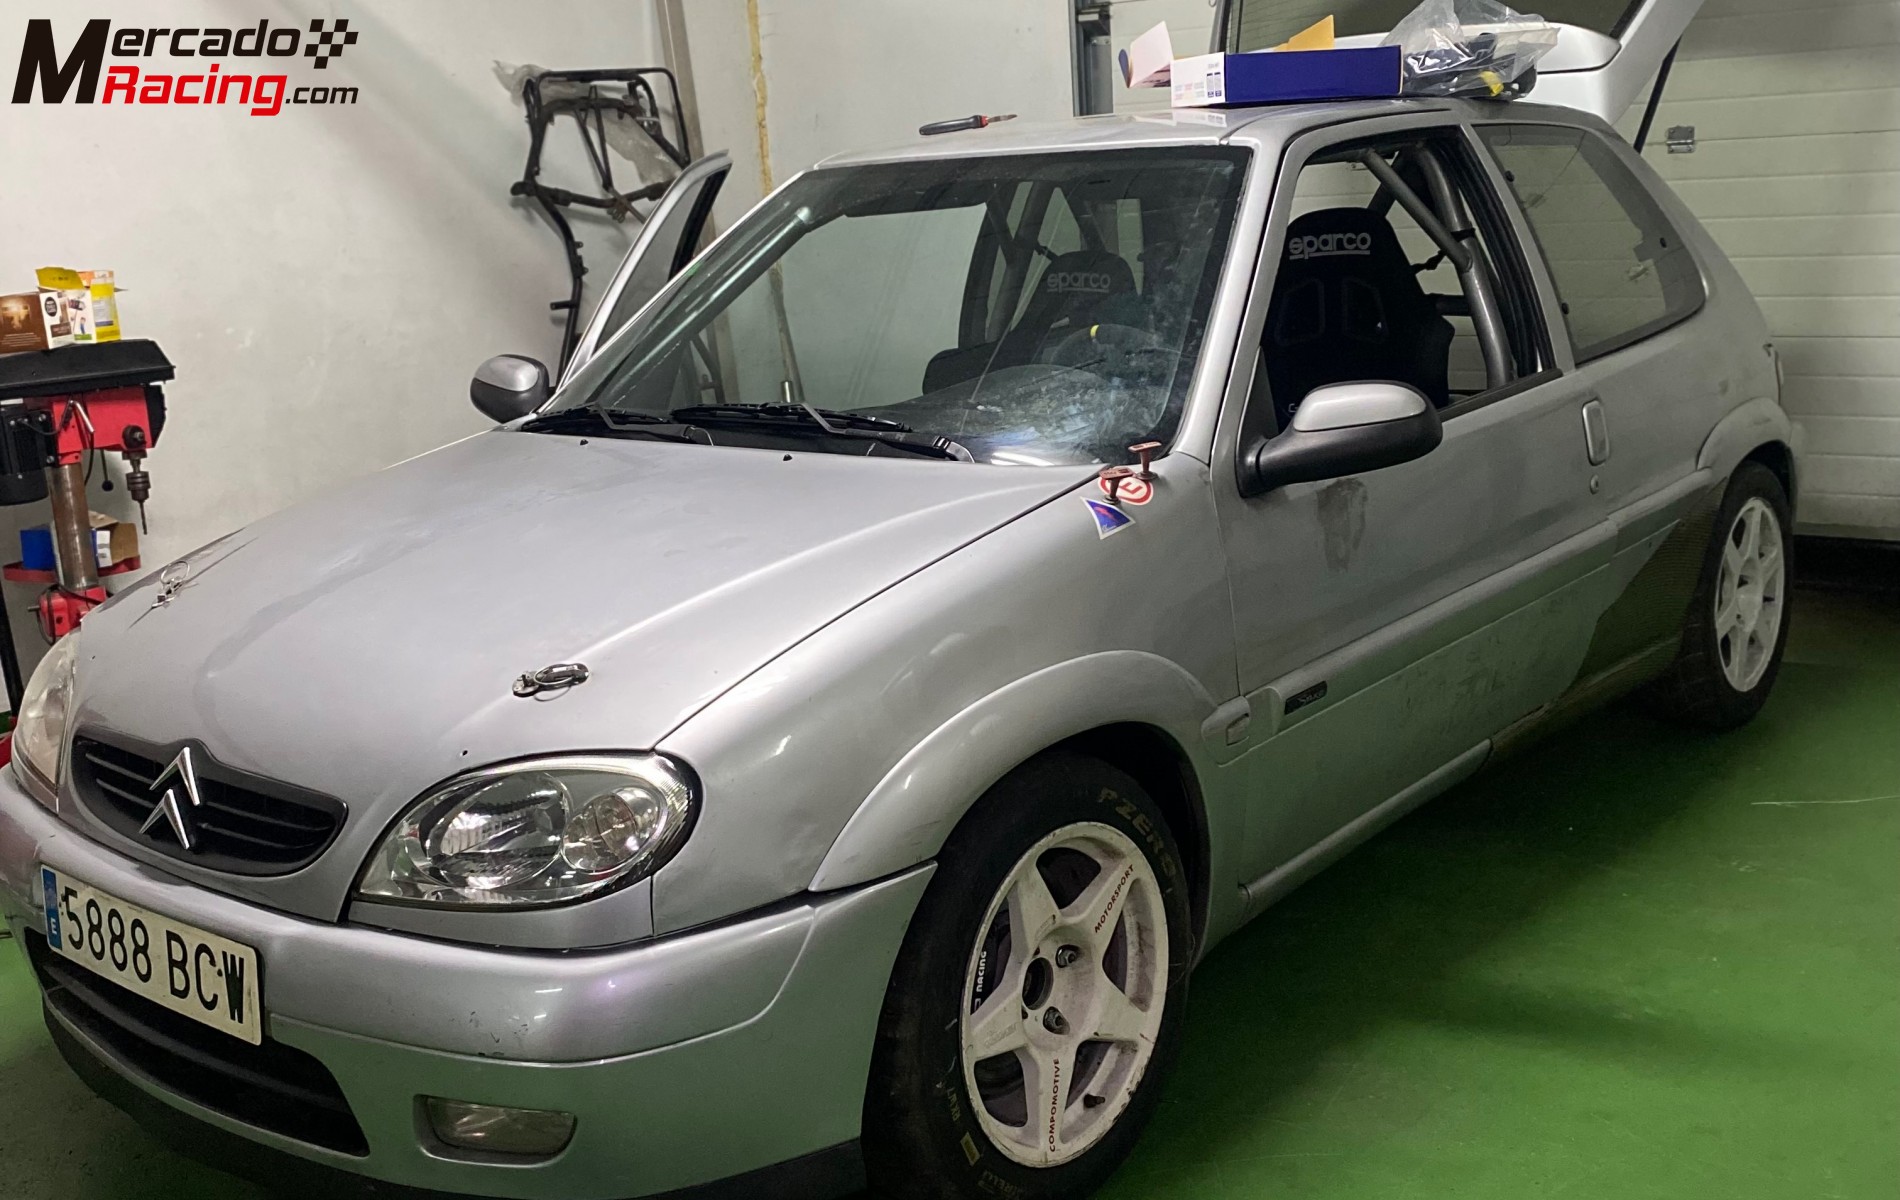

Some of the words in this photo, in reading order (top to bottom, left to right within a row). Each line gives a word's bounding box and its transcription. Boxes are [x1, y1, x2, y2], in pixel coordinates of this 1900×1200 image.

[1288, 231, 1372, 260] sparco
[1047, 270, 1111, 293] sparco
[1093, 863, 1135, 934] MOTORSPORT
[50, 917, 58, 935] E
[64, 885, 153, 984] 5888
[165, 929, 245, 1025] BCW
[1048, 1057, 1061, 1153] COMPOMOTIVE
